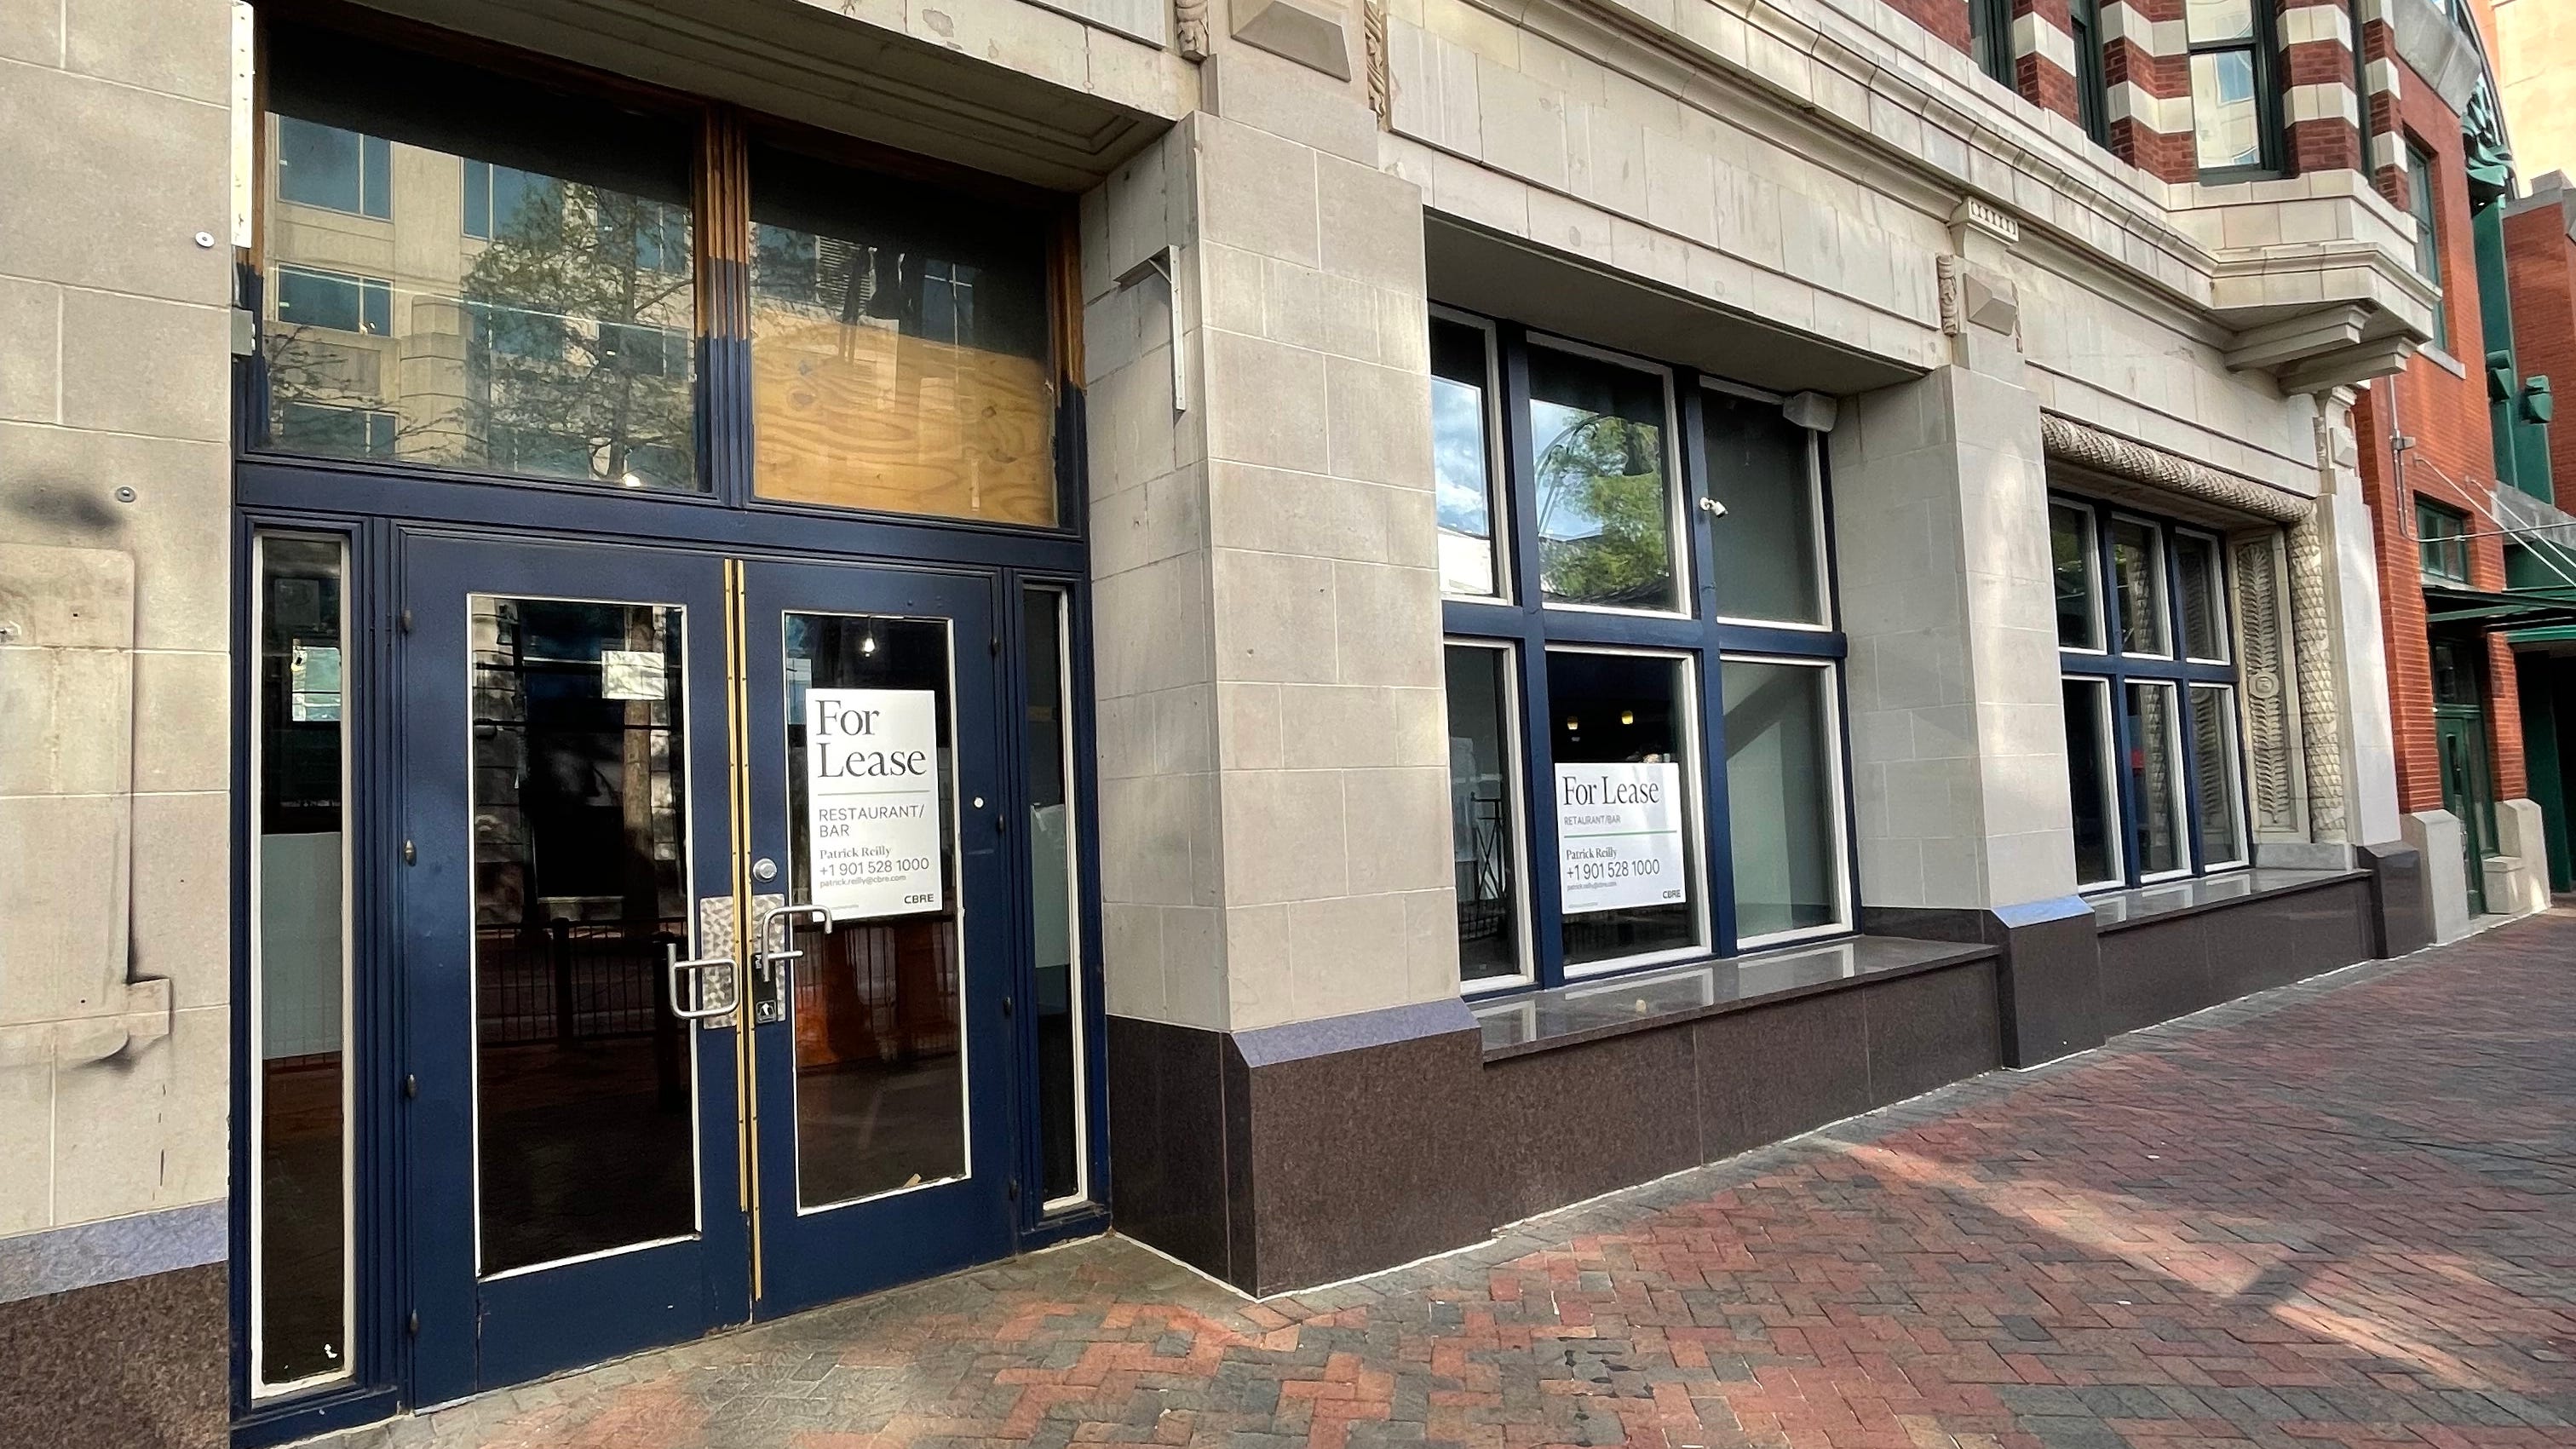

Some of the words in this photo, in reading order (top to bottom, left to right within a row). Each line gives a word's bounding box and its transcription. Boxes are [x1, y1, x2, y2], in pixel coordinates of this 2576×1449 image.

[815, 699, 880, 736] For
[816, 742, 927, 778] Lease
[1561, 776, 1597, 806] For
[1601, 776, 1659, 805] Lease
[819, 804, 925, 822] RESTAURANT/
[819, 824, 850, 838] BAR
[819, 847, 860, 860] Patrick
[861, 845, 892, 859] Reilly
[1566, 848, 1594, 860] Patrick
[1596, 847, 1618, 860] Reilly
[819, 864, 835, 877] +1
[839, 862, 864, 876] 901
[867, 860, 893, 874] 528
[896, 858, 929, 872] 1000
[1567, 865, 1580, 881] +1
[1583, 862, 1605, 880] 901
[1607, 860, 1629, 878] 528
[1631, 859, 1660, 877] 1000
[904, 894, 934, 904] CBRE
[1662, 889, 1682, 900] CBRE
